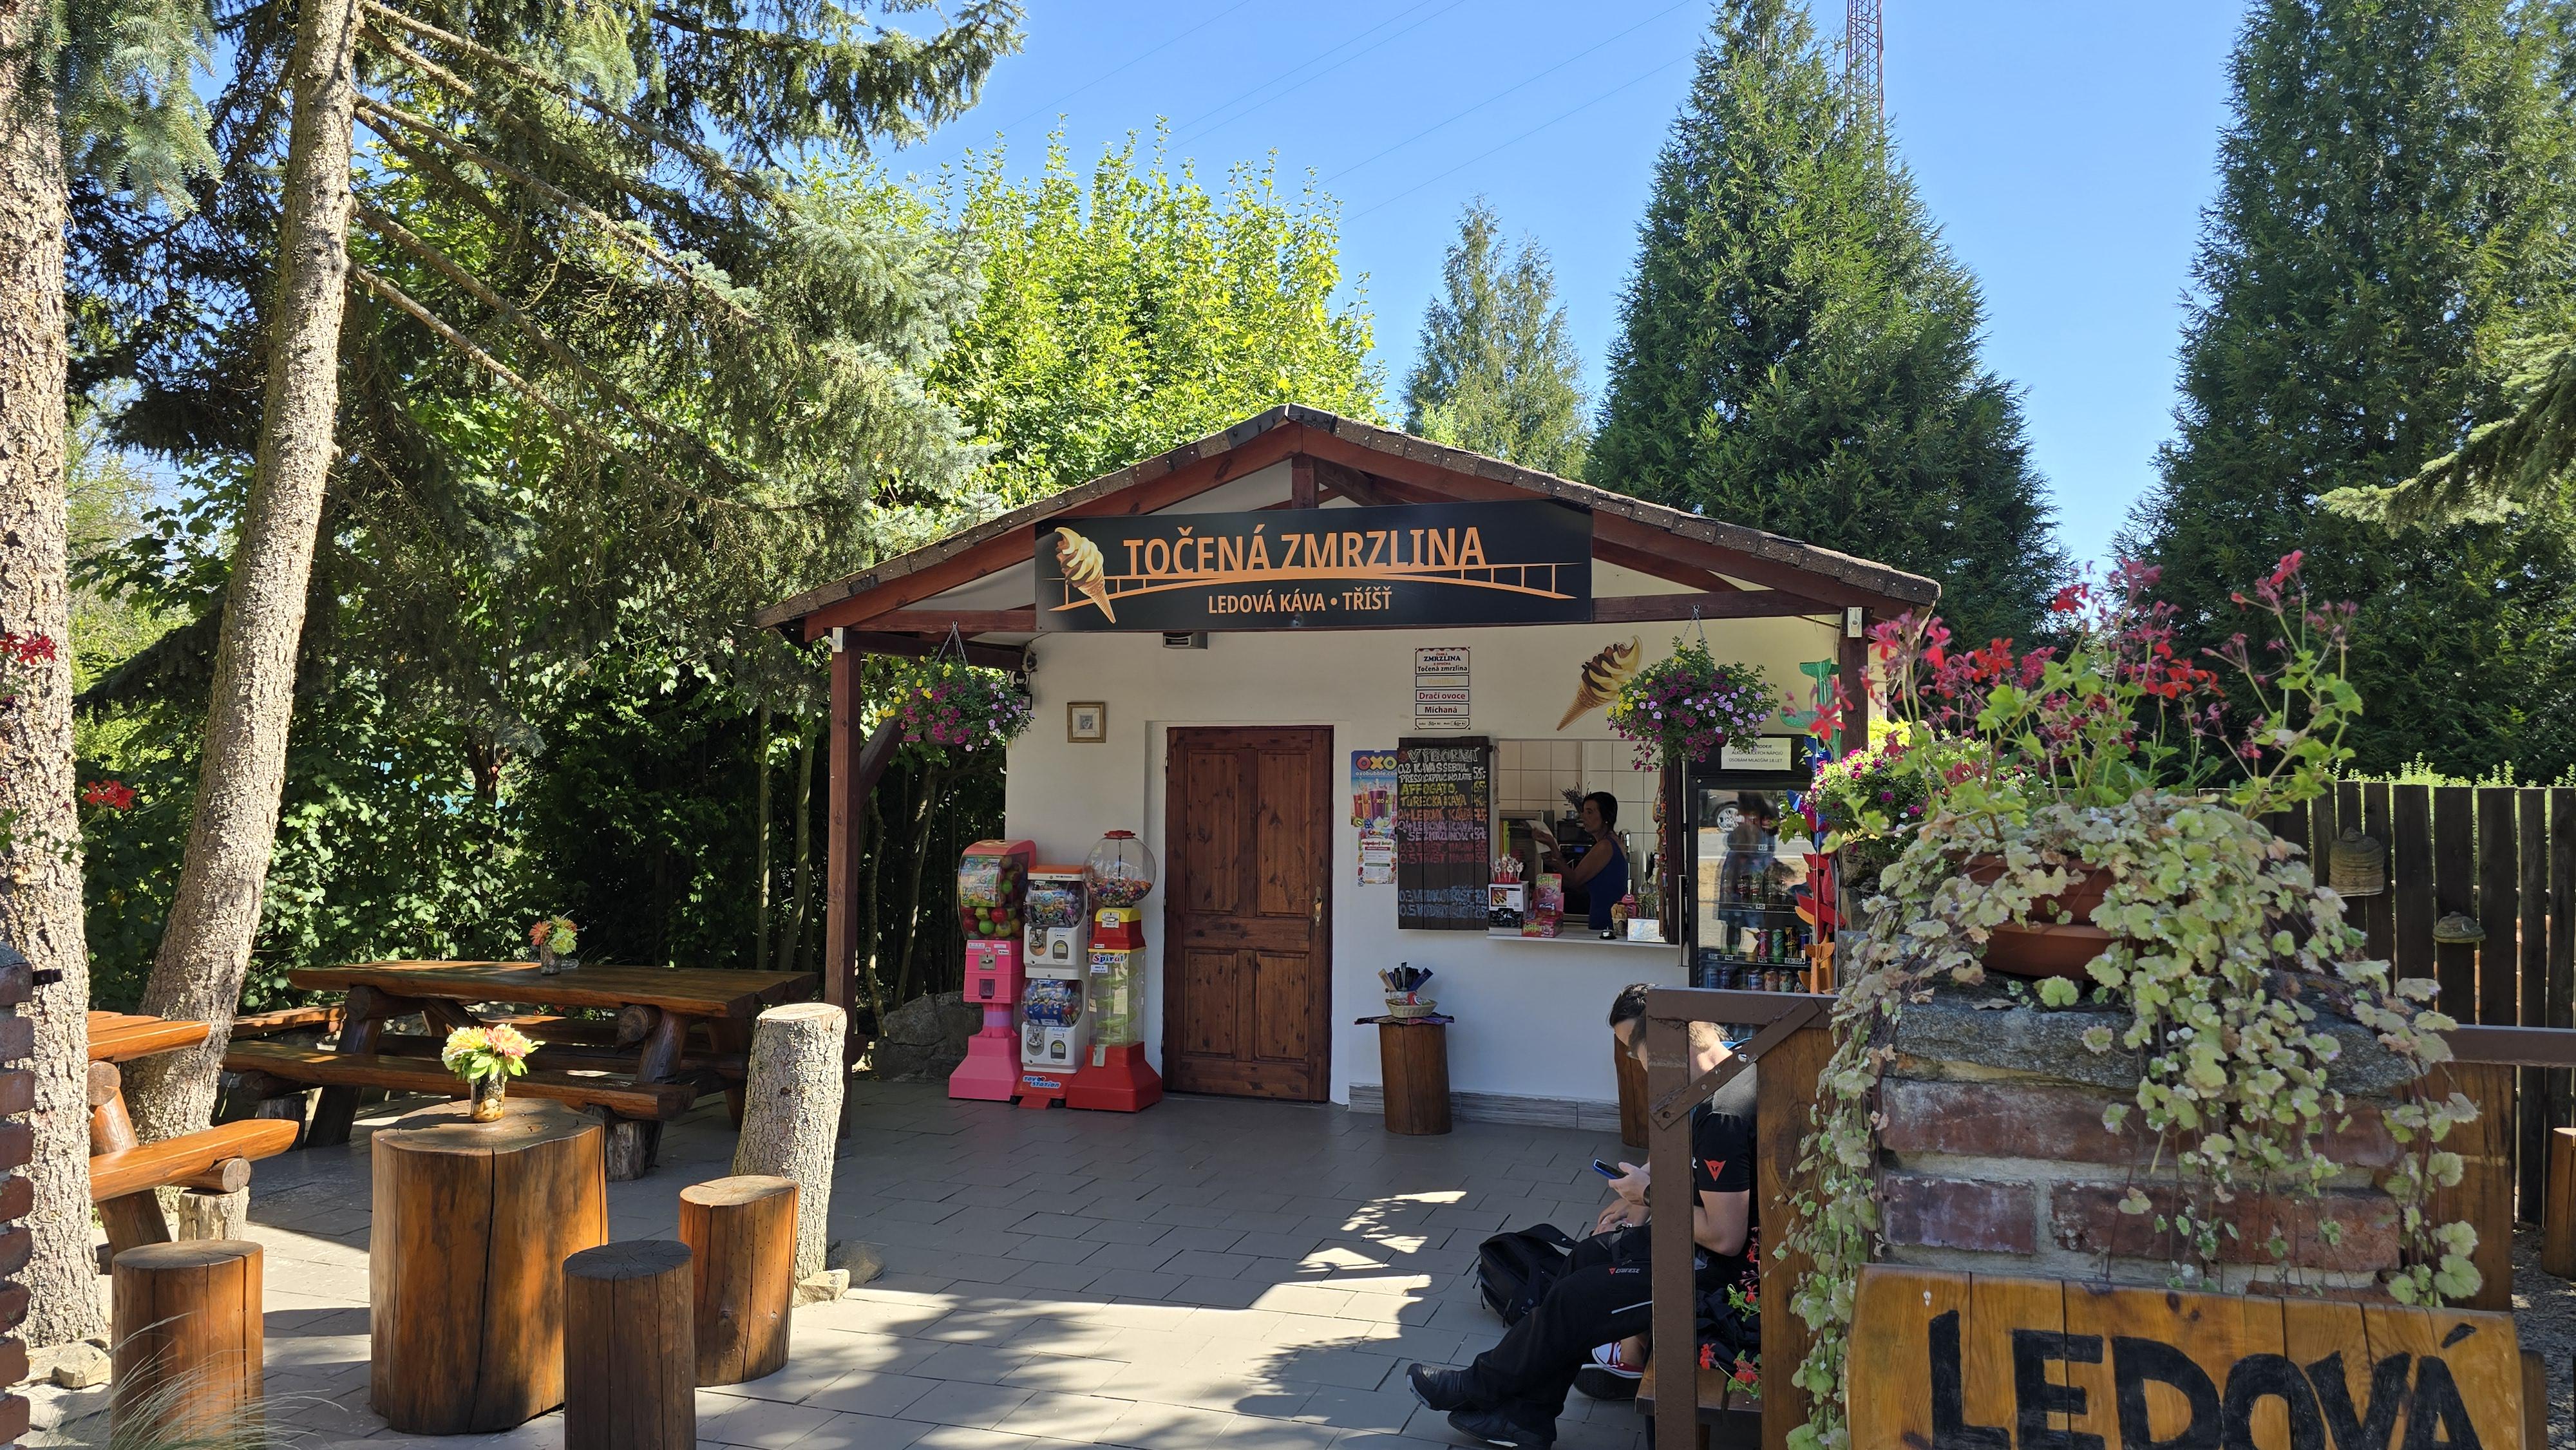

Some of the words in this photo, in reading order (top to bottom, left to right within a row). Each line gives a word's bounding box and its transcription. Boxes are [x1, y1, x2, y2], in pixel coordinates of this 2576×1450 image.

[1123, 523, 1271, 575] TOČENÁ
[1281, 527, 1486, 568] ZMRZLINA
[1208, 588, 1276, 614] LEDOVÁ
[1280, 588, 1326, 612] KÁVA
[1342, 585, 1392, 610] TŘÍŠŤ
[1356, 756, 1397, 771] OXO
[1929, 1310, 2481, 1450] LEDOVÁ
